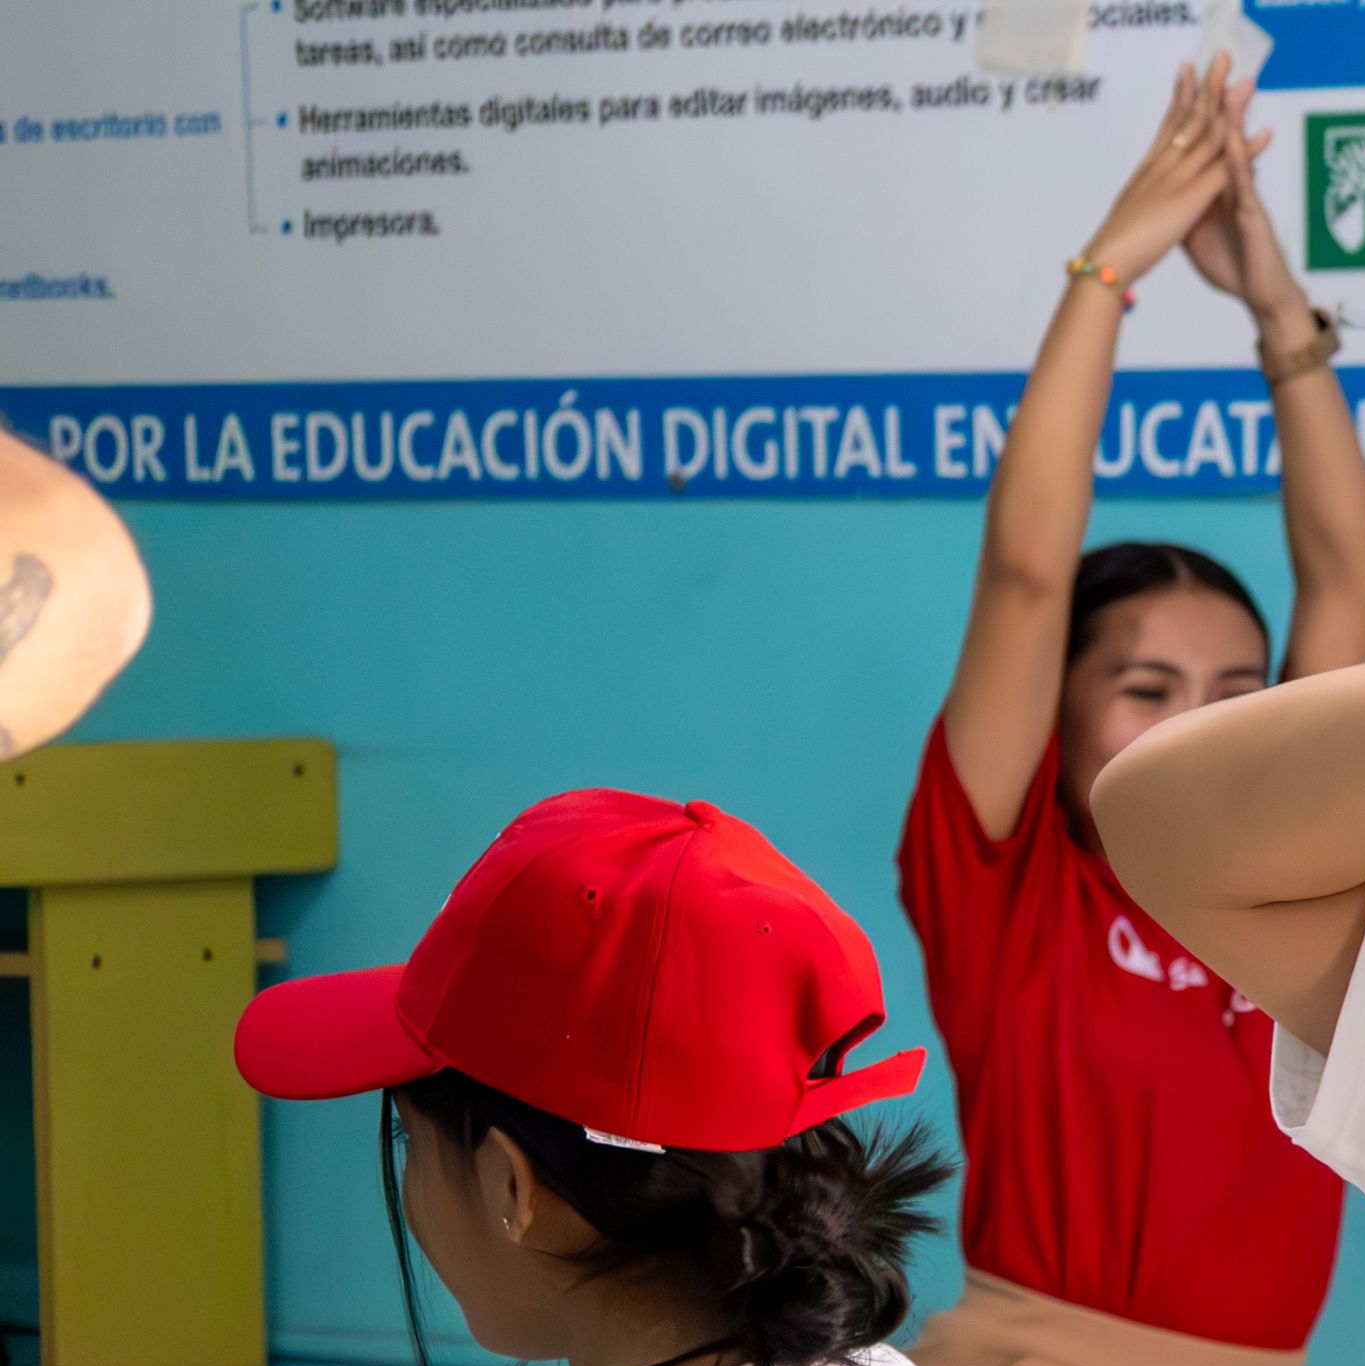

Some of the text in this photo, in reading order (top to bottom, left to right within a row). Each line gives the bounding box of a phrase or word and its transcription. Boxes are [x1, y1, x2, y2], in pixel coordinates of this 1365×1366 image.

[433, 33, 506, 60] como
[514, 22, 629, 57] consulta
[637, 20, 671, 50] de
[680, 20, 770, 48] correo
[299, 102, 472, 134] Herramientas
[479, 94, 591, 134] digitales
[599, 96, 661, 128] para
[669, 84, 748, 119] editar
[911, 77, 992, 109] audio
[1000, 83, 1015, 112] y
[1024, 75, 1103, 103] crear
[301, 147, 469, 182] animaciones.
[50, 414, 166, 482] POR
[184, 414, 255, 482] LA
[272, 389, 642, 482] EDUCACIÓN
[664, 403, 916, 480] DIGITAL
